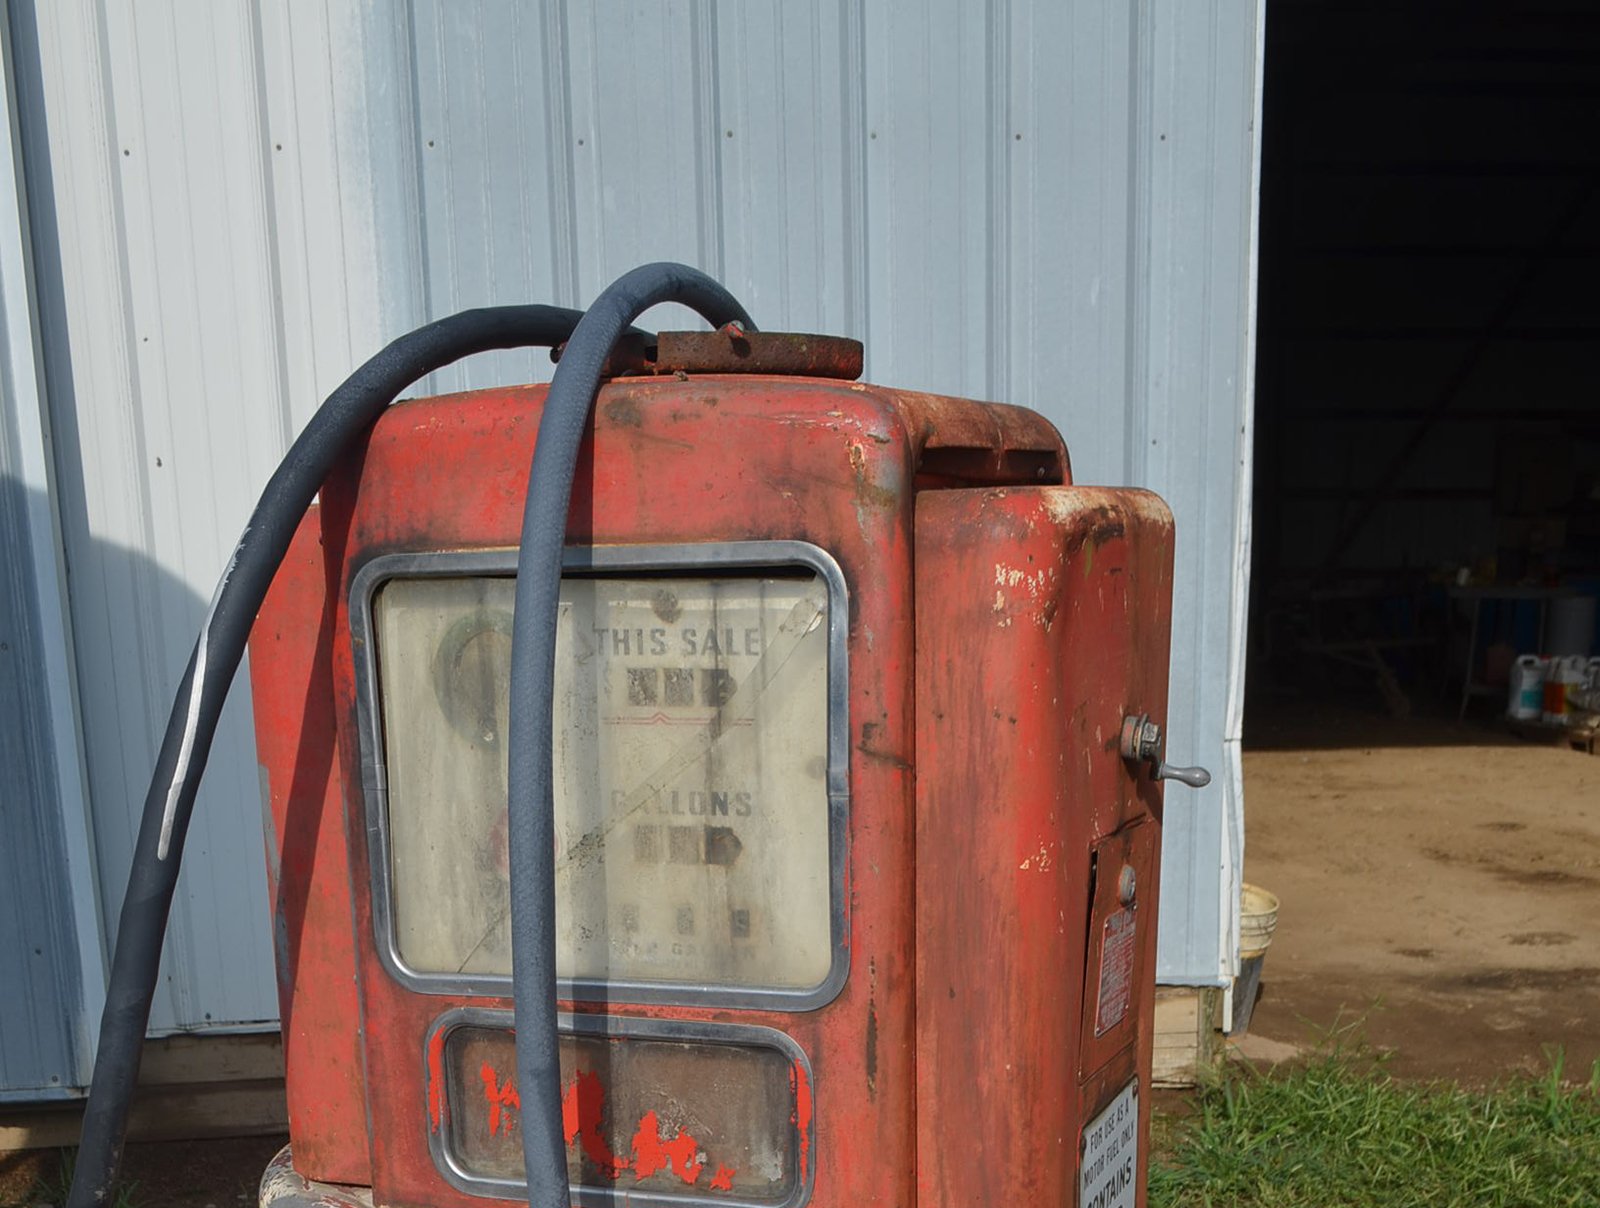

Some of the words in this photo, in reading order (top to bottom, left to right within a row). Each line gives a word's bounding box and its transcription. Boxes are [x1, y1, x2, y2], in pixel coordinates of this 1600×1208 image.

[593, 628, 667, 656] THIS
[681, 628, 760, 657] SALE
[1090, 1127, 1103, 1154] FOR
[1104, 1112, 1116, 1139] USE
[1117, 1103, 1124, 1122] AS
[1084, 1154, 1105, 1191] MOTOR
[1106, 1138, 1119, 1166] FUEL
[1121, 1121, 1134, 1148] ONLY
